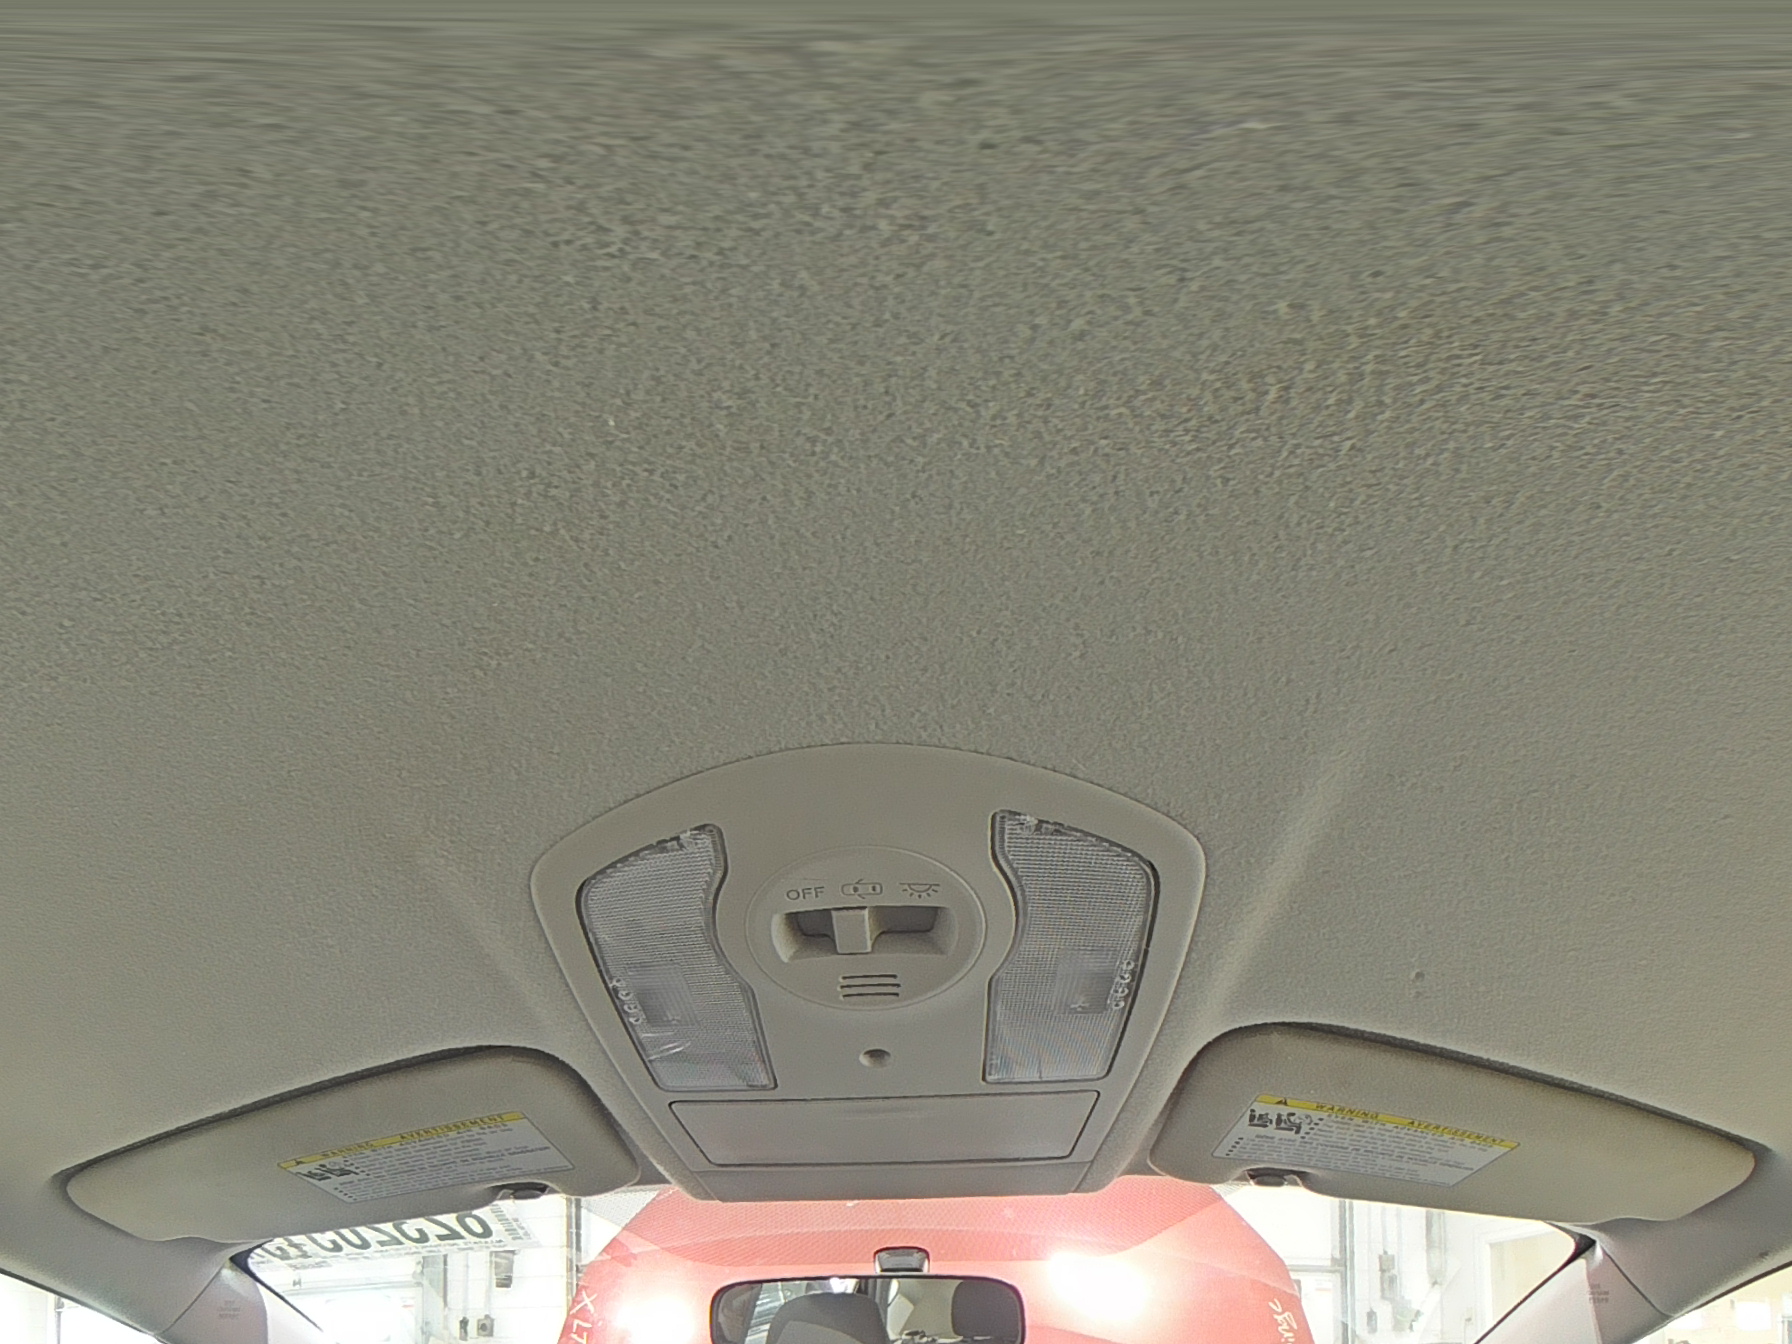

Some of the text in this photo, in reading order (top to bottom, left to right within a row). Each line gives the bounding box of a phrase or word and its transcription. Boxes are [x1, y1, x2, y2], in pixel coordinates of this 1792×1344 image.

[786, 886, 825, 901] OFF
[1315, 1103, 1380, 1120] WARNING
[569, 1289, 598, 1315] X
